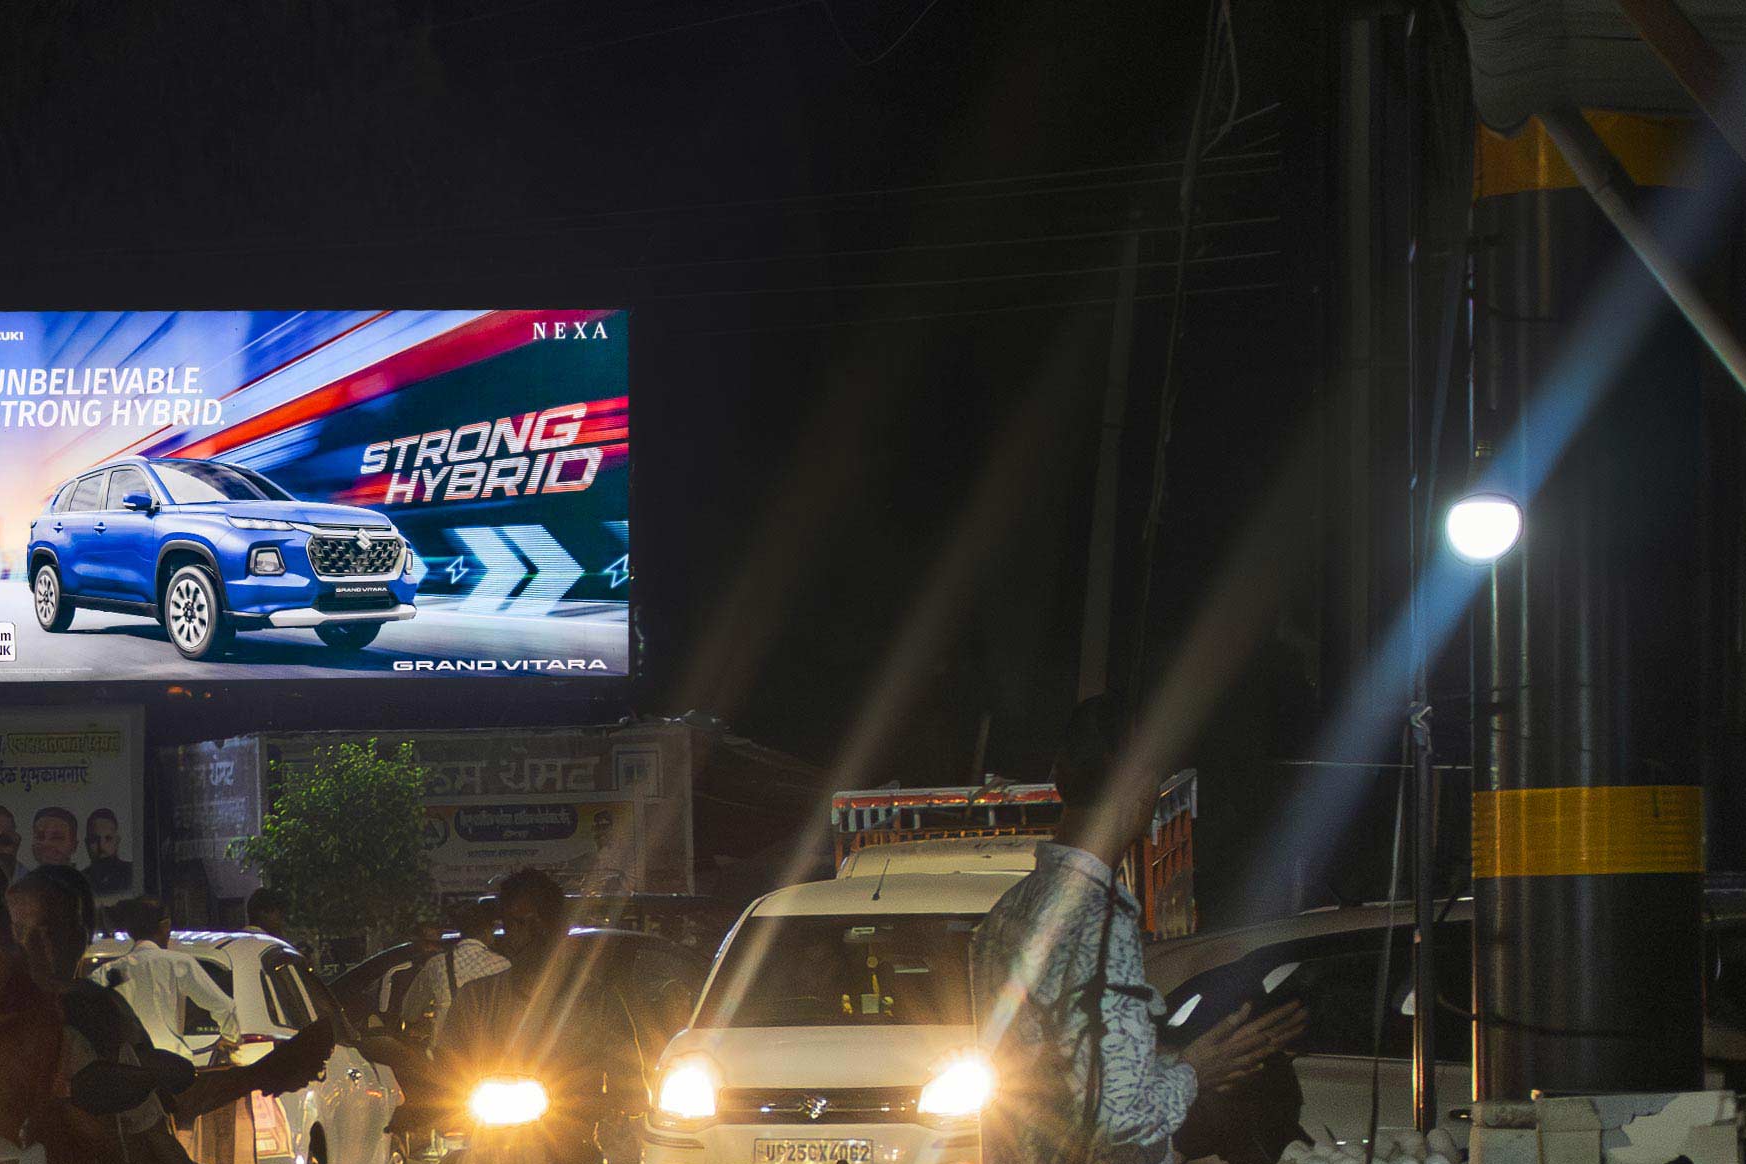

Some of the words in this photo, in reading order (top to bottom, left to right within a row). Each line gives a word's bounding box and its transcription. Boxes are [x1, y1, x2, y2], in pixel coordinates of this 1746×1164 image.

[533, 322, 608, 340] NEXA
[111, 398, 226, 427] HYBRID.
[360, 402, 587, 475] STRONG
[384, 447, 604, 504] HYBRID
[393, 660, 496, 671] GRAND
[501, 659, 607, 671] VITARA
